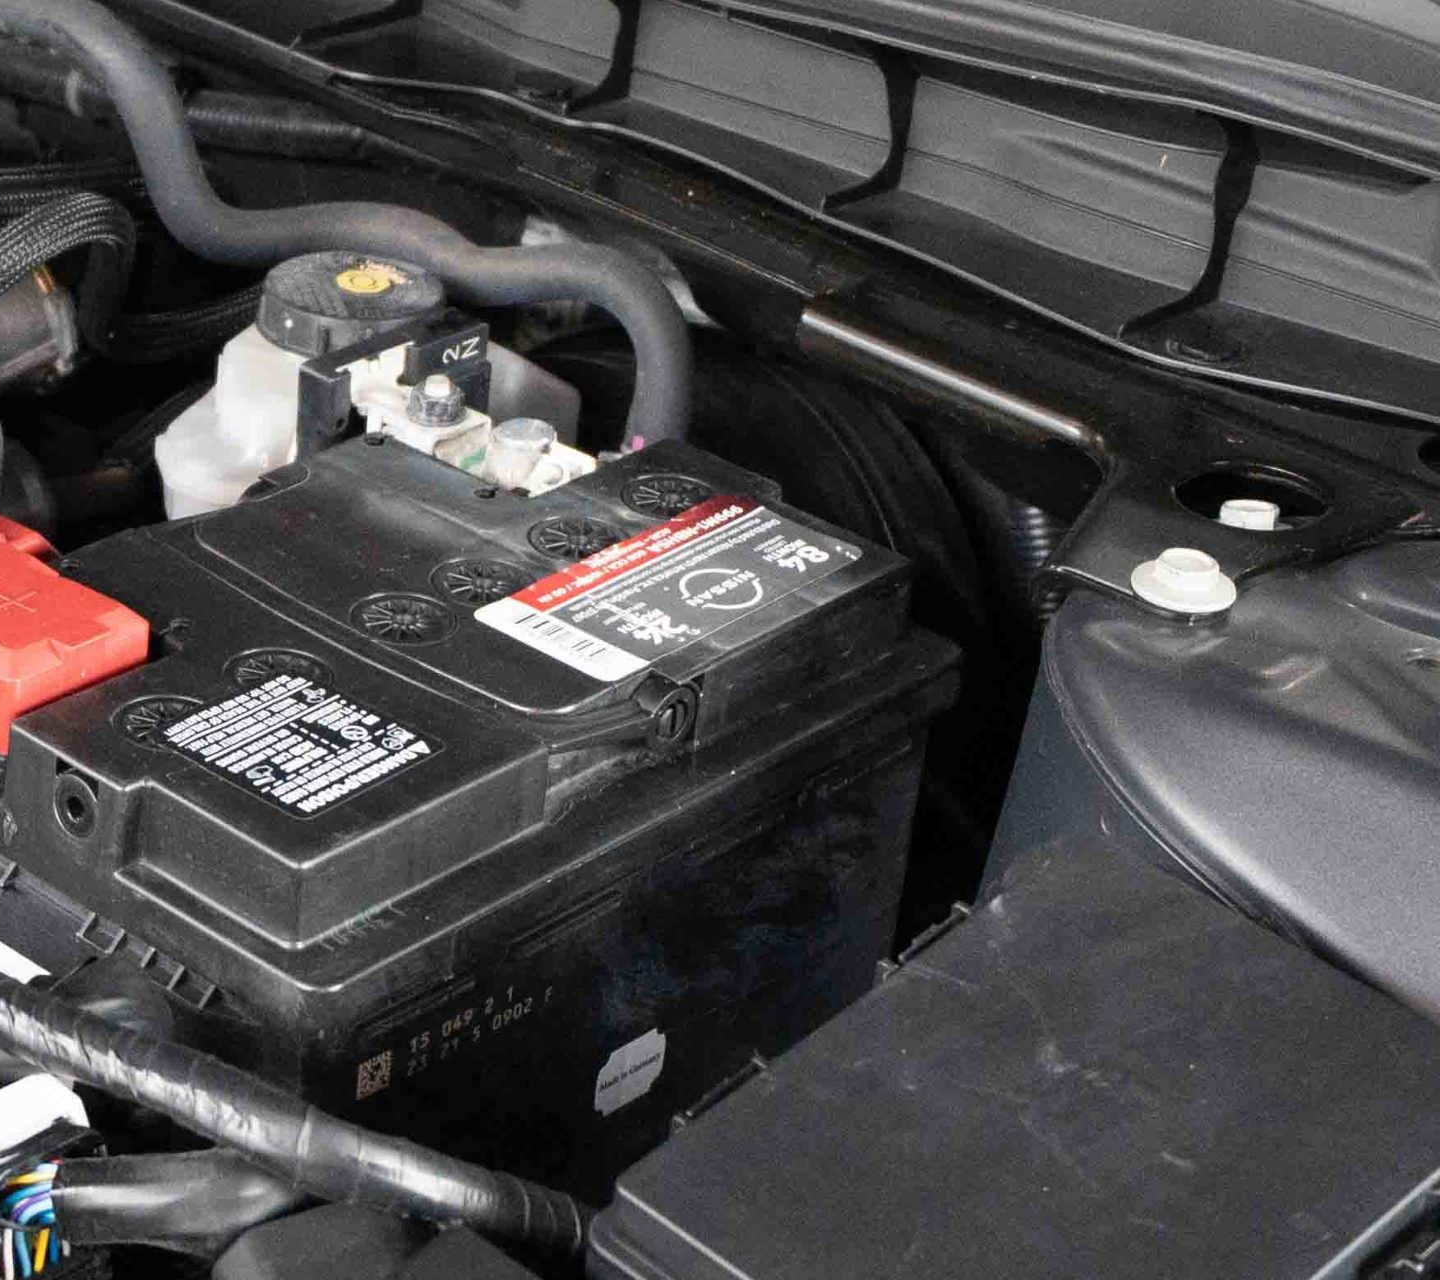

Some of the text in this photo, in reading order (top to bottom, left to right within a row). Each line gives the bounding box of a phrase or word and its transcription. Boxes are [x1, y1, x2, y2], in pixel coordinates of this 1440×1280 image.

[776, 545, 829, 573] 84
[682, 569, 757, 607] NISSAN
[484, 997, 493, 1015] 2
